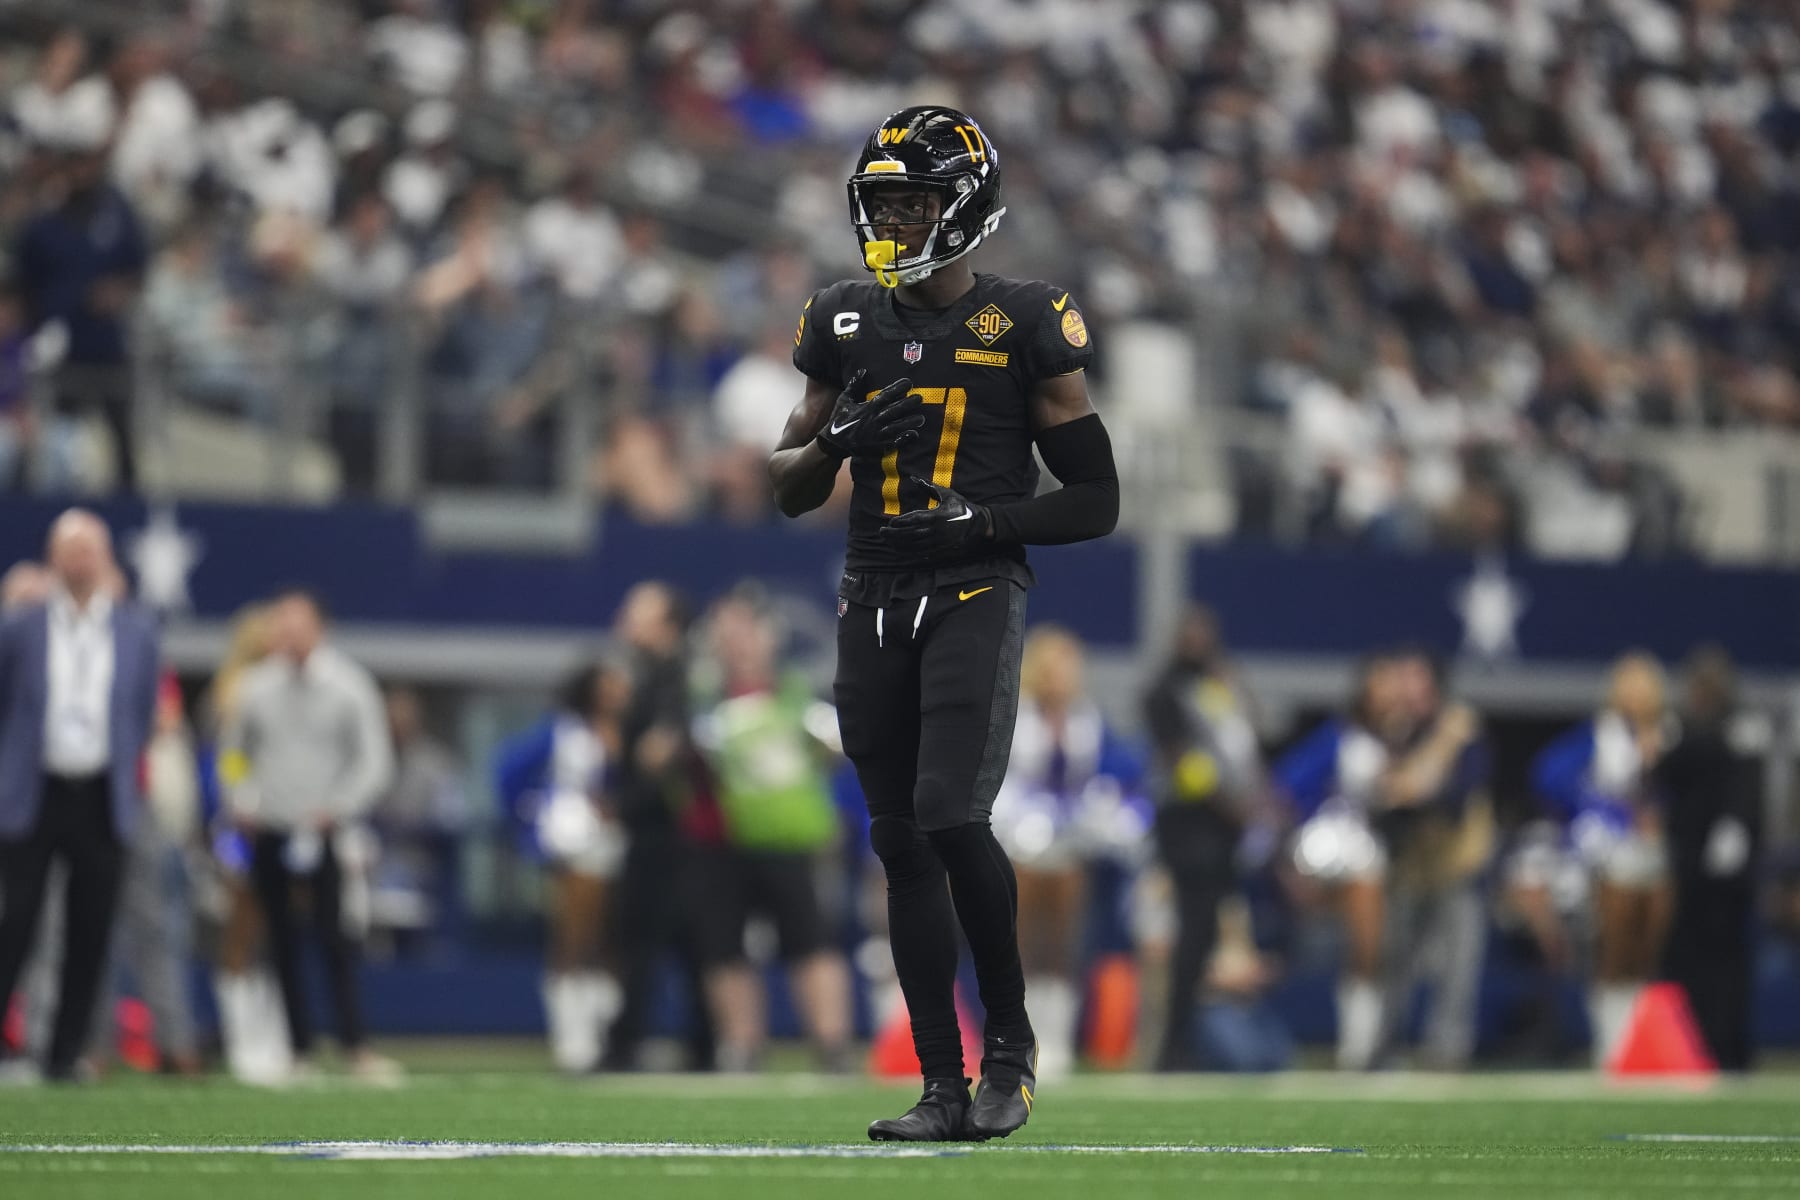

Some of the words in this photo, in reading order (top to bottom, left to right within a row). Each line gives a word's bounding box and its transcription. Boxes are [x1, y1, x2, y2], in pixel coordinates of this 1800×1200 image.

[880, 128, 909, 144] W
[954, 125, 986, 163] 17
[834, 312, 860, 335] C
[979, 313, 1001, 335] 90
[955, 351, 1008, 365] COMMANDERS
